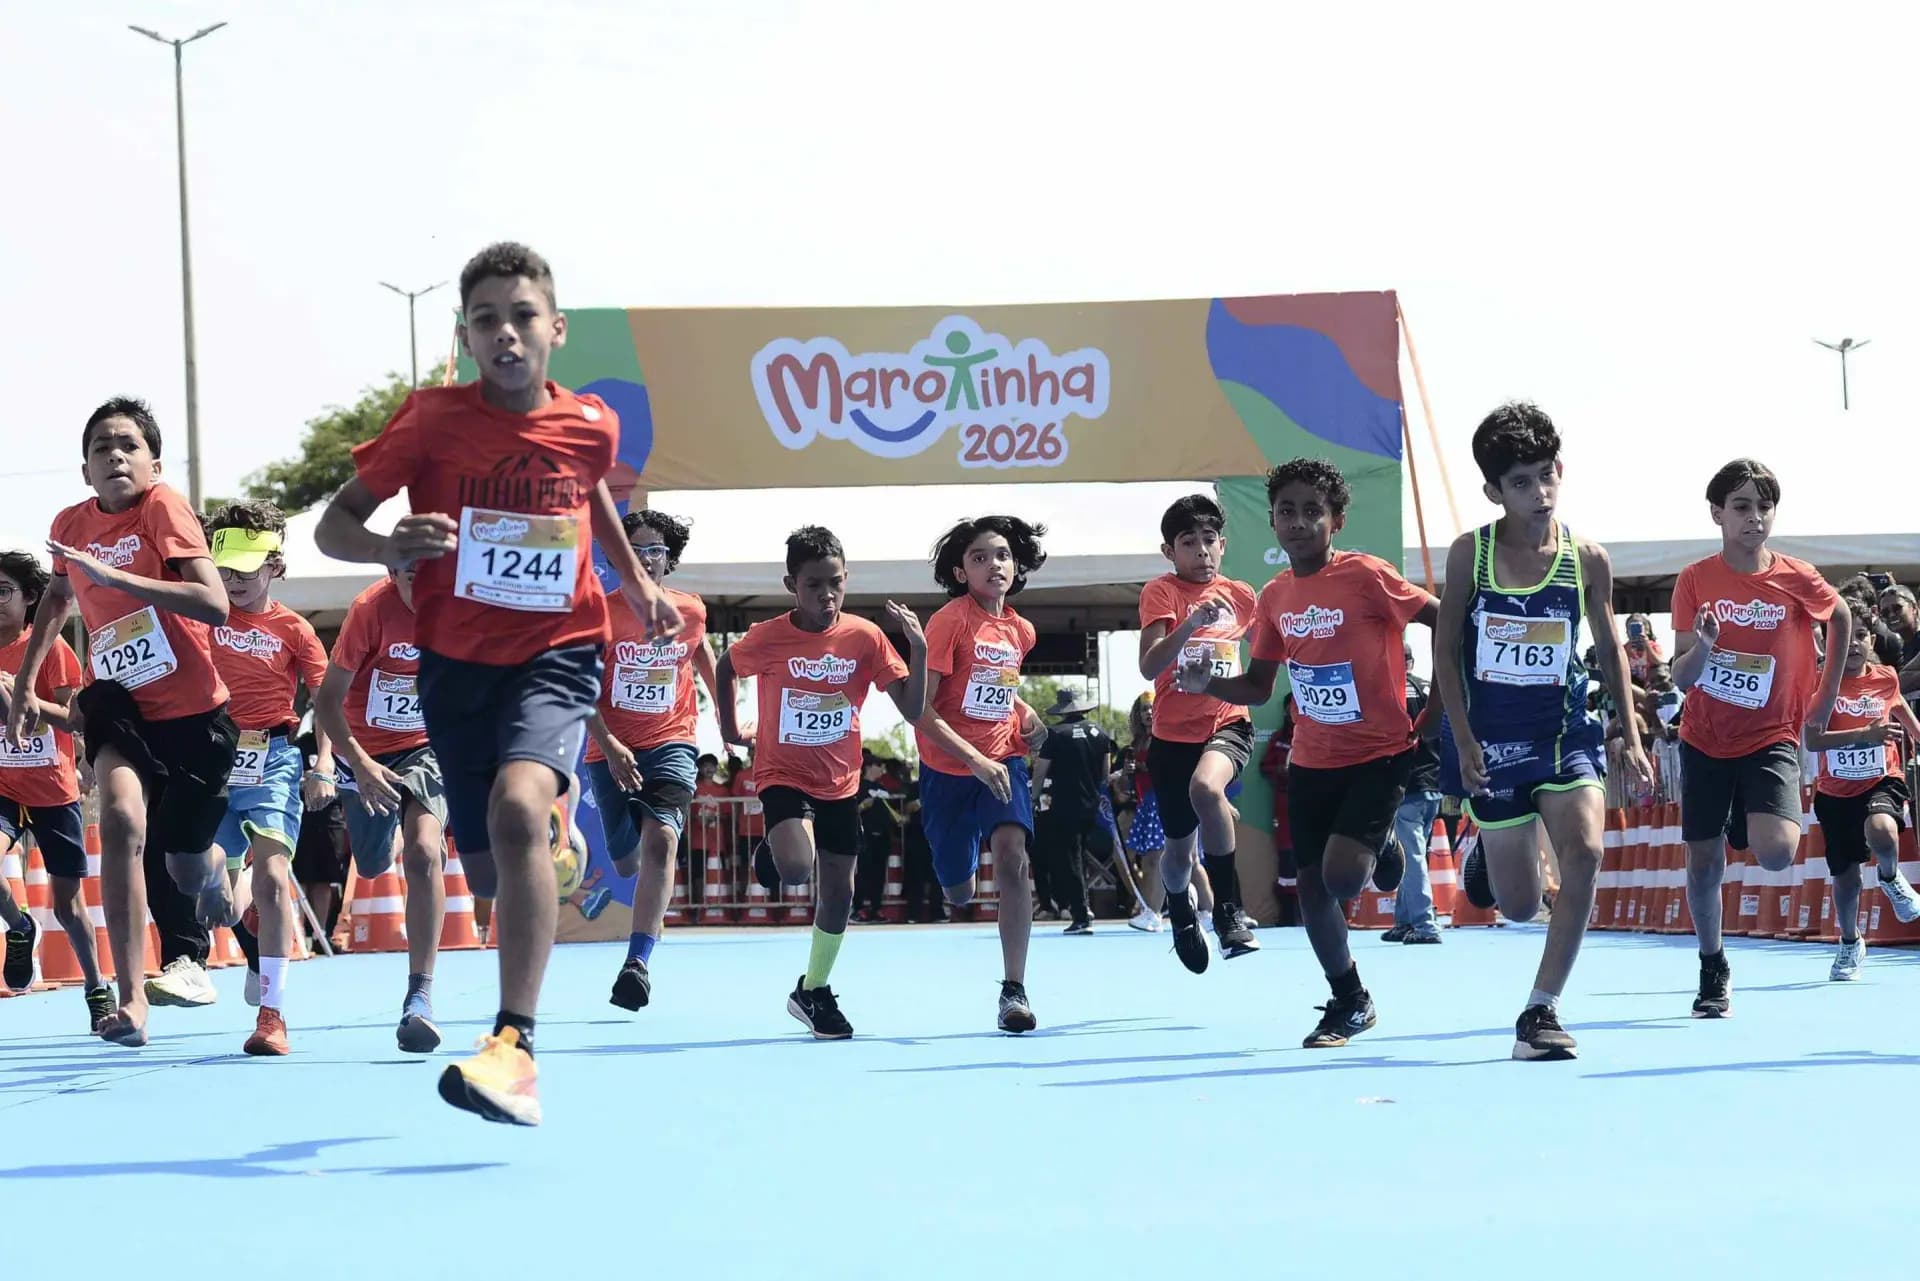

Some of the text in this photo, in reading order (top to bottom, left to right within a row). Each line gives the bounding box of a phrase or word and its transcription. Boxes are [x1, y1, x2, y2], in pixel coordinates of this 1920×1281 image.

[766, 331, 1095, 433] Marotinha
[964, 423, 1062, 462] 2026
[482, 548, 562, 581] 1244
[1719, 602, 1783, 618] Marotinha
[1282, 608, 1339, 635] Marotinha
[217, 629, 279, 648] Marotinha
[1314, 628, 1333, 637] 2026
[101, 638, 155, 676] 1292
[1494, 641, 1554, 666] 7163
[791, 657, 854, 675] Marotinha
[829, 674, 847, 682] 2026
[1710, 666, 1759, 692] 1256
[625, 684, 665, 700] 1251
[974, 685, 1012, 705] 1290
[1300, 684, 1347, 706] 9029
[384, 695, 423, 715] 124
[794, 711, 843, 730] 1298
[234, 751, 258, 769] 52
[1837, 749, 1875, 766] 8131
